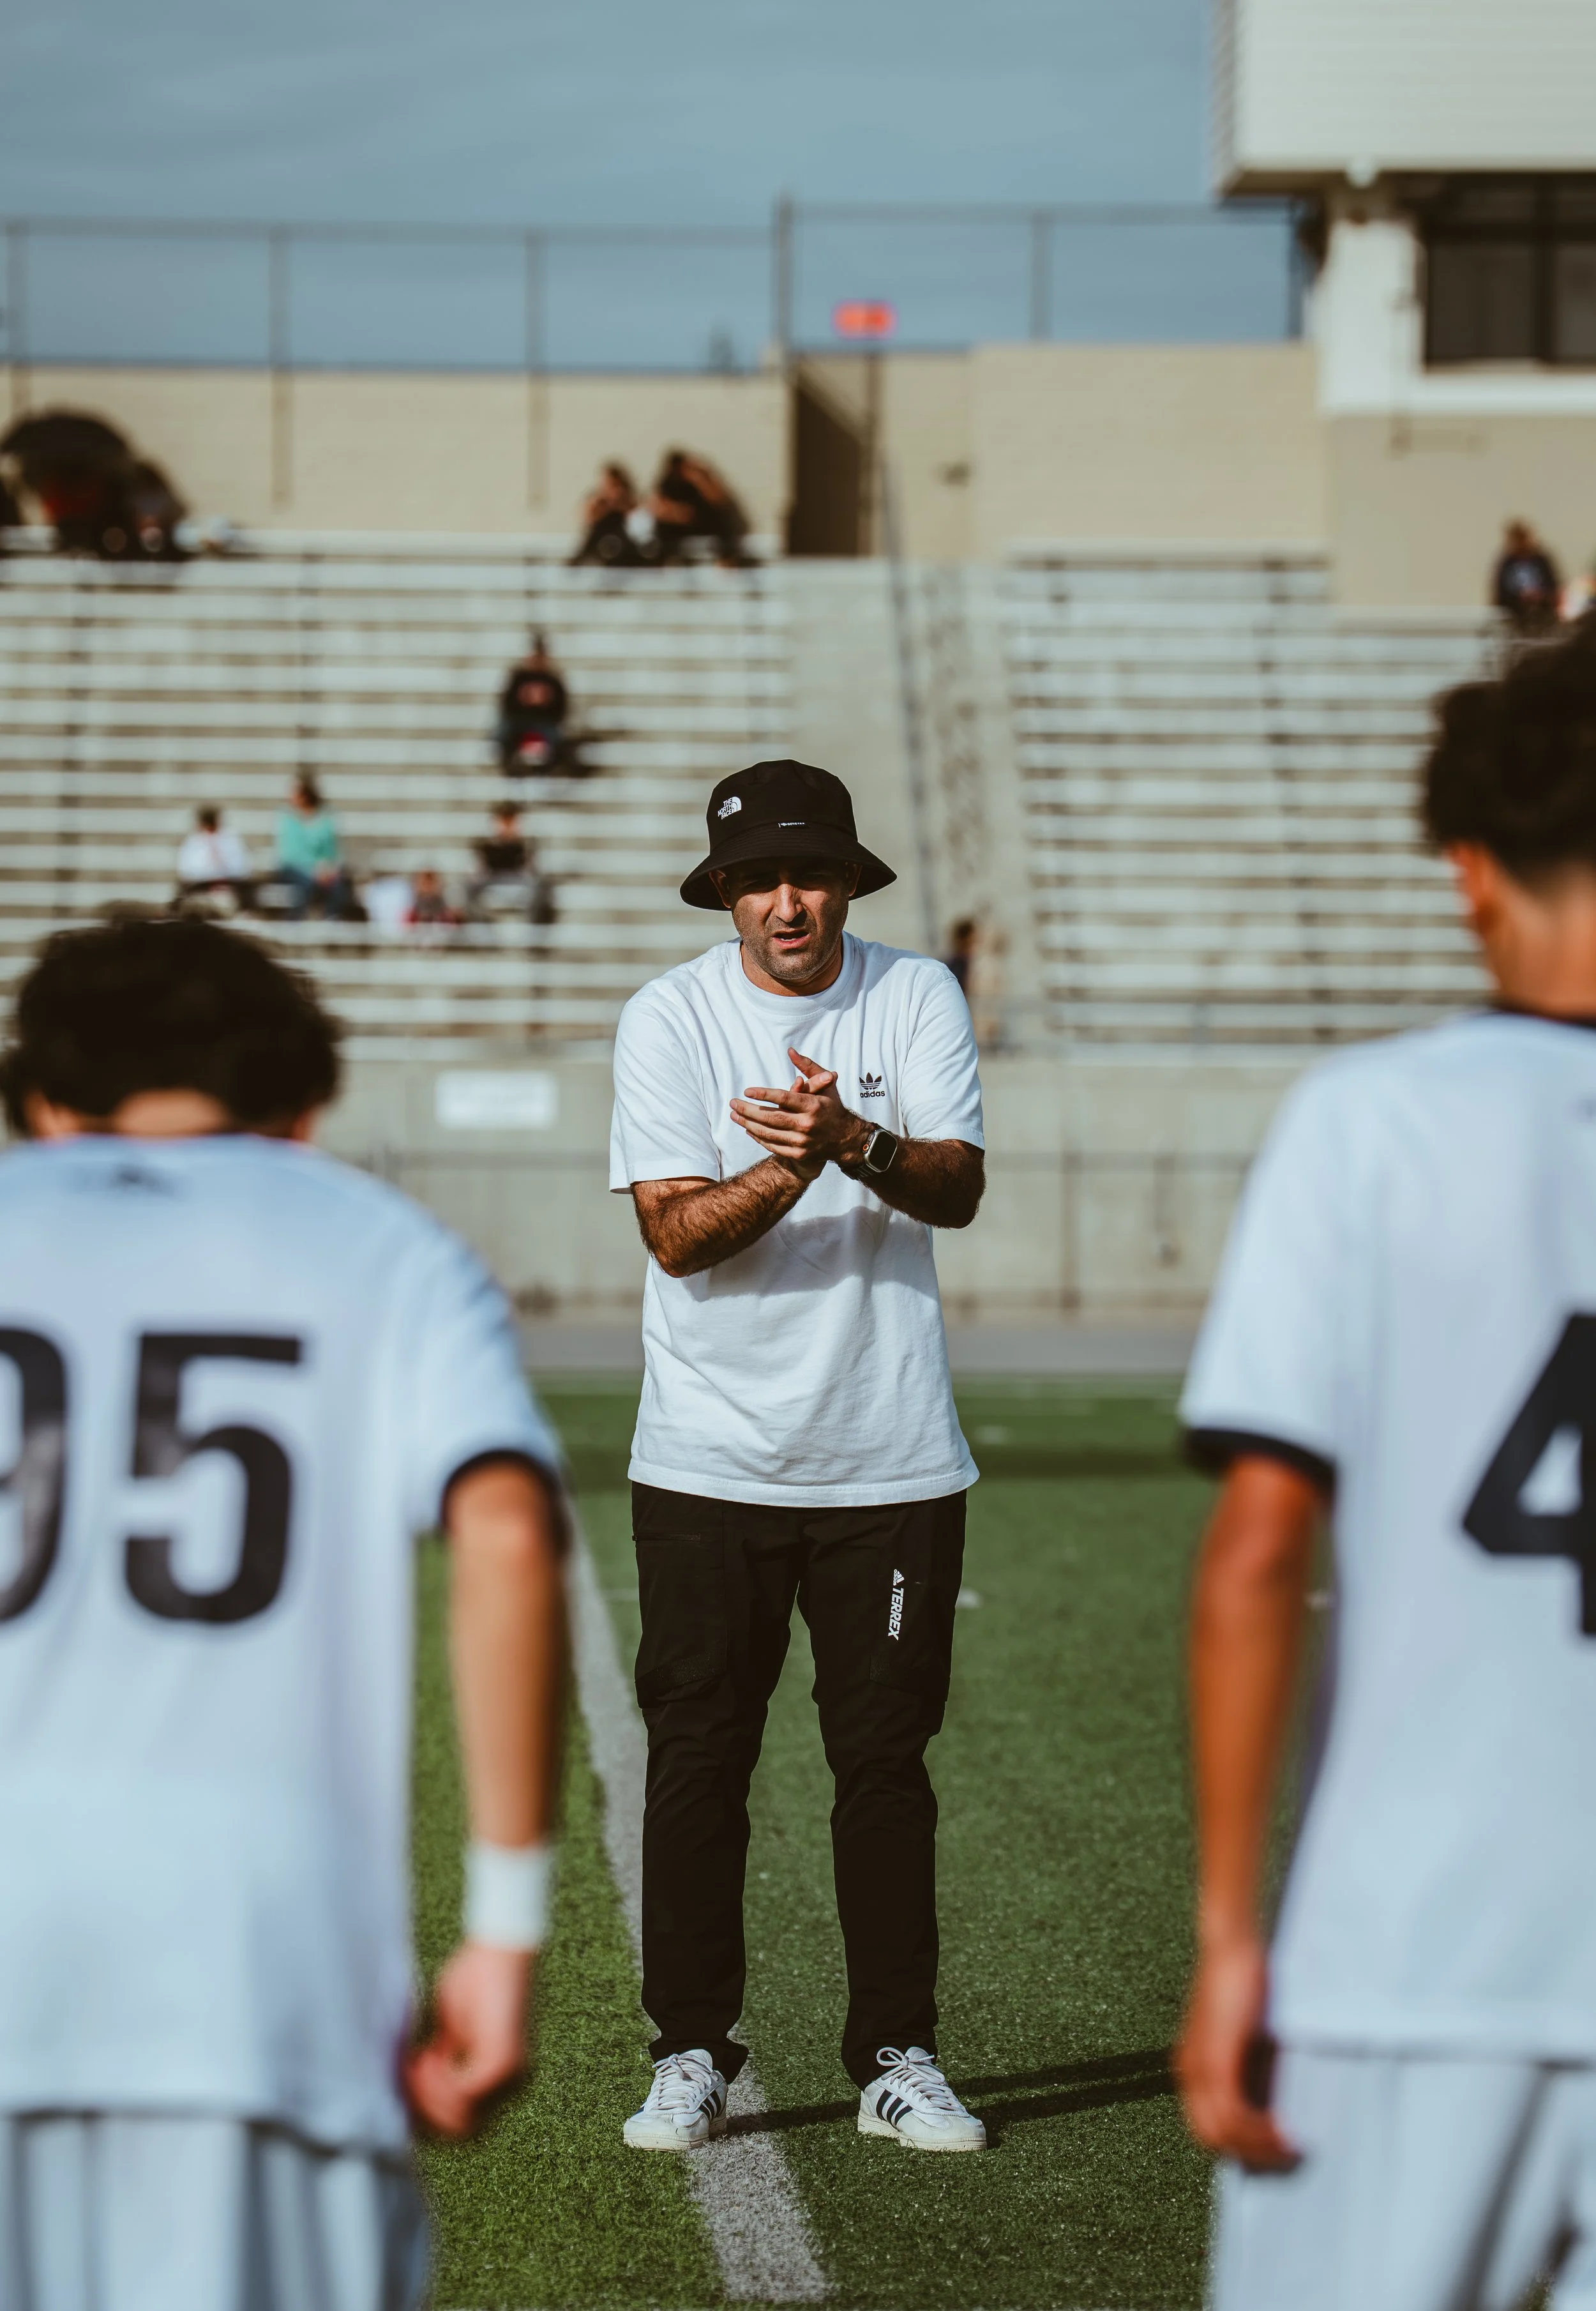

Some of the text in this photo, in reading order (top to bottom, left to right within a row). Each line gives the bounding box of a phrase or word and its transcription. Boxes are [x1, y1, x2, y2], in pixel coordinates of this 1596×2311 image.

[723, 797, 732, 807] THE
[718, 803, 732, 817] NORTH
[721, 809, 732, 820] FACE
[1461, 1312, 1596, 1637] 4
[888, 1587, 904, 1640] TERREX
